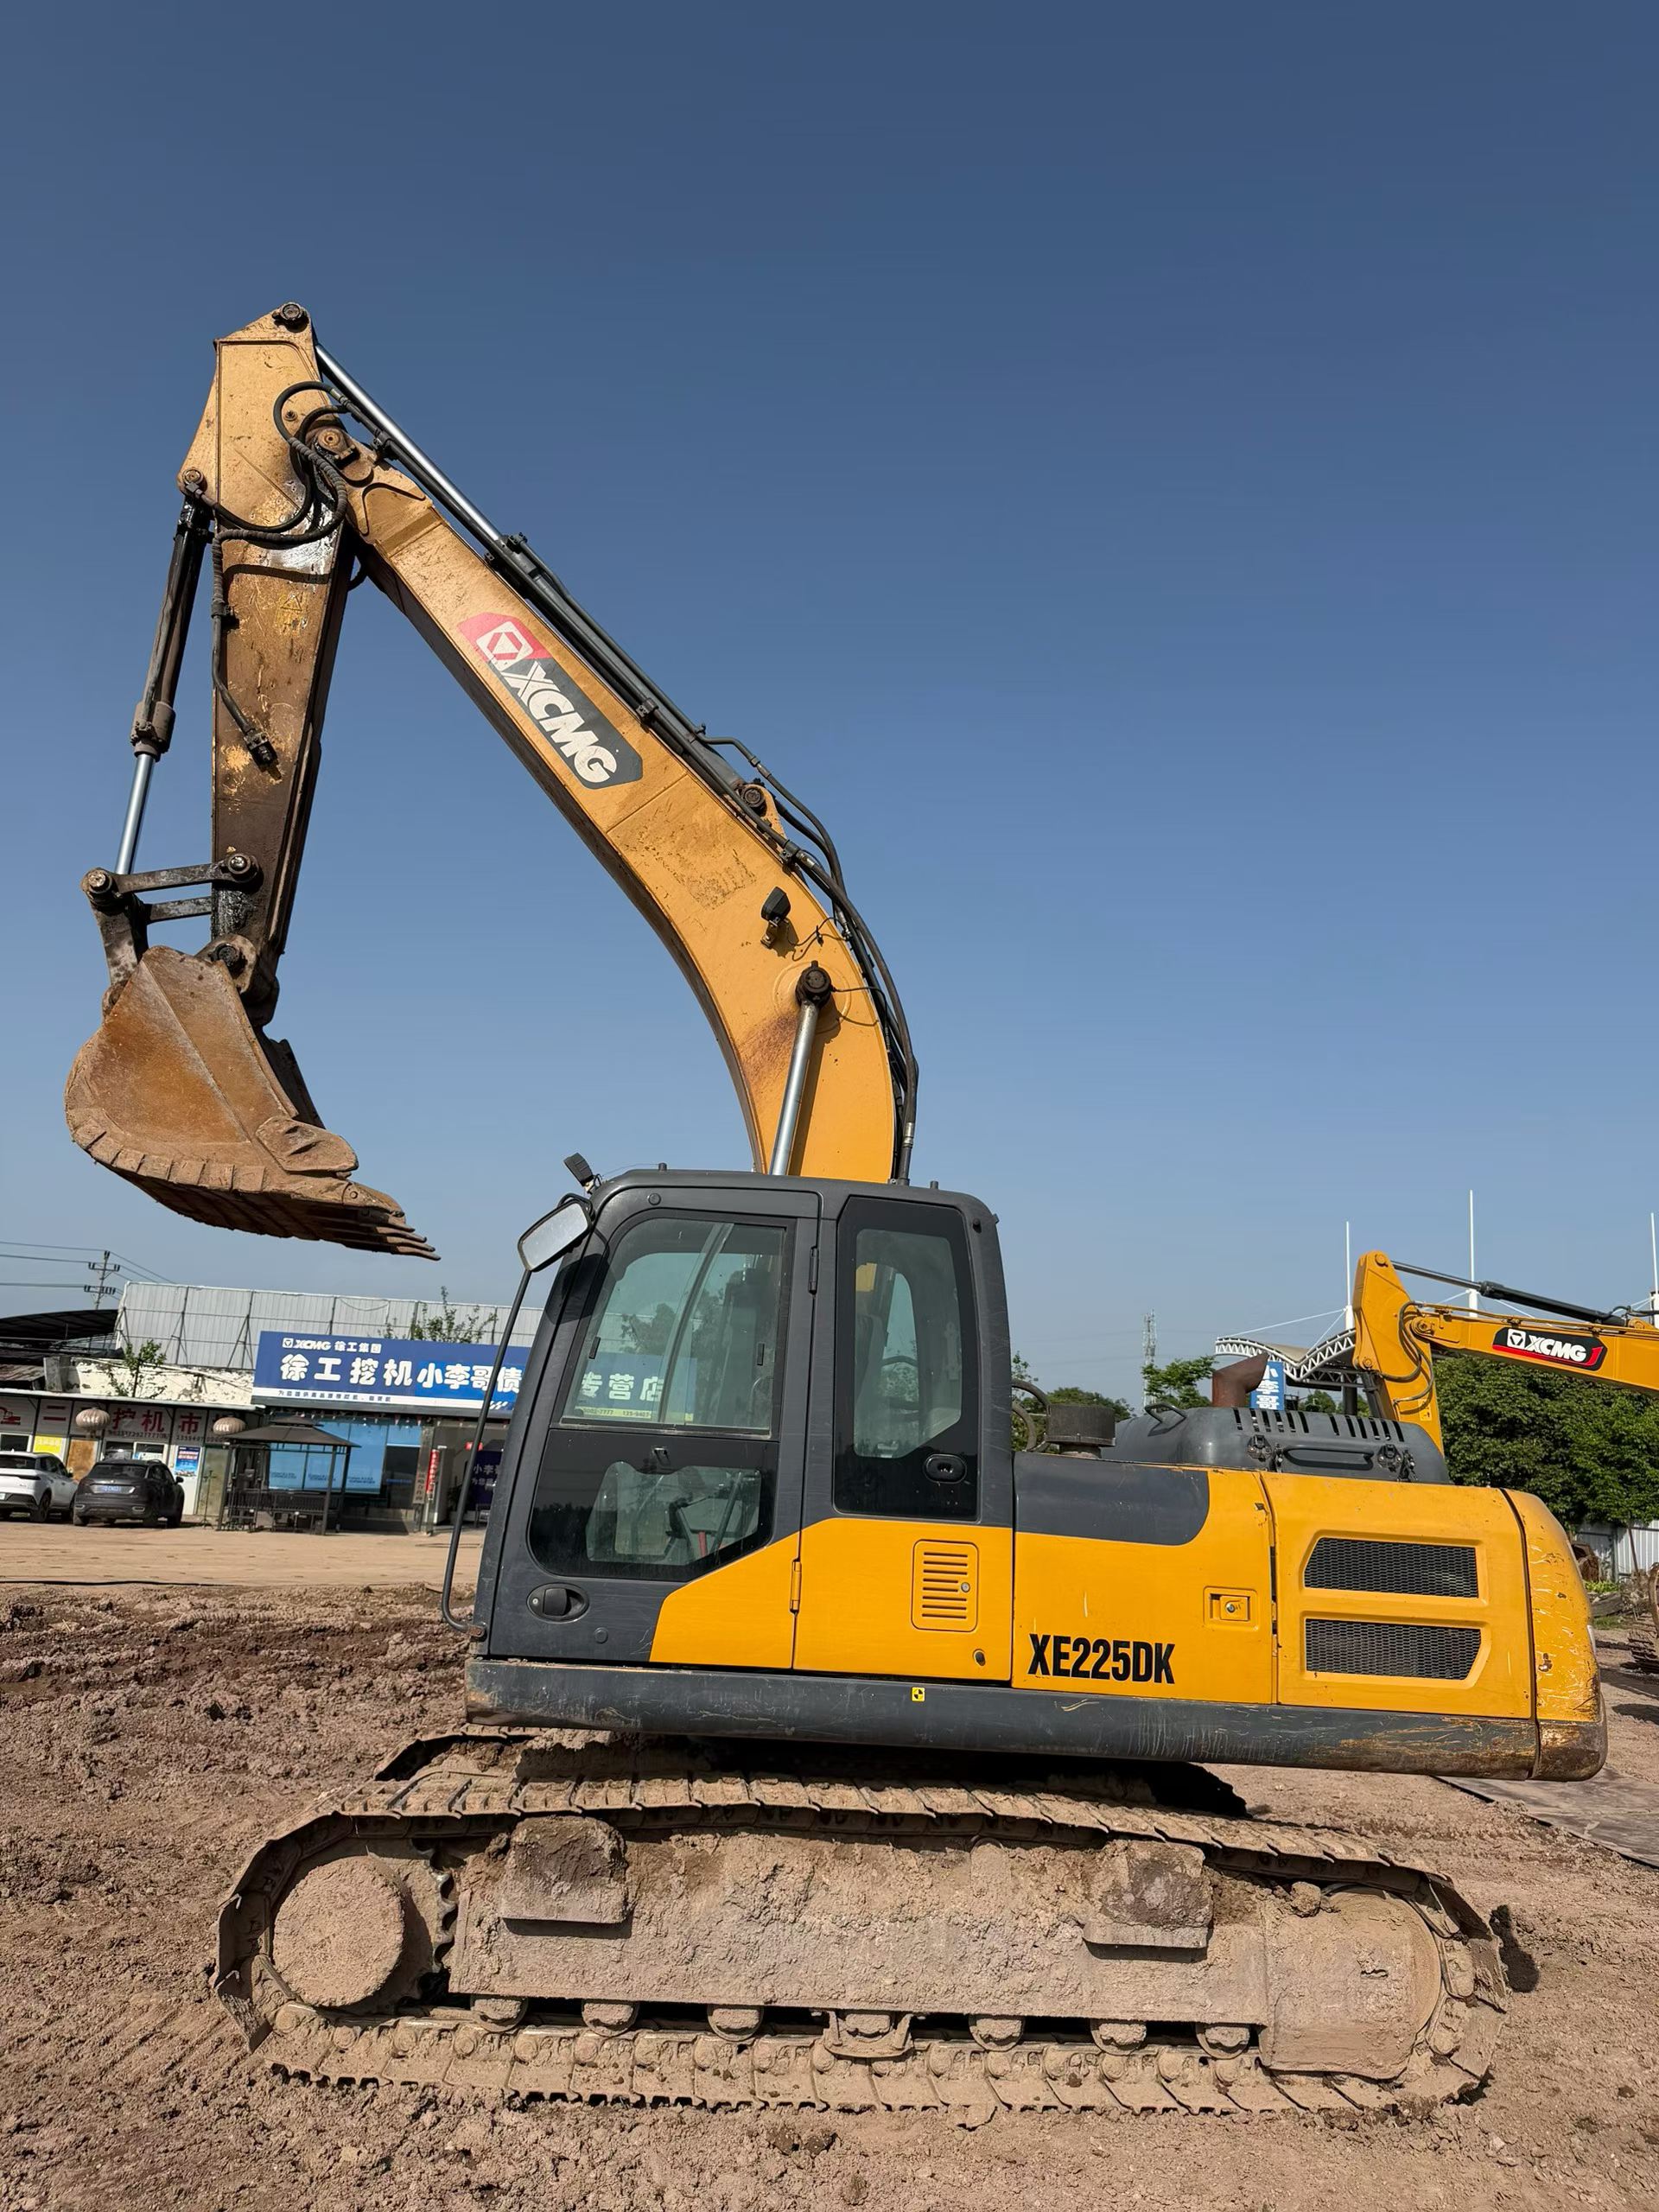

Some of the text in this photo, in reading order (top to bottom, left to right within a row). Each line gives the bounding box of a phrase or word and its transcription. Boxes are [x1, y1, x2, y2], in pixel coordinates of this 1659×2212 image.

[502, 661, 617, 783] XCMG
[1524, 1335, 1586, 1363] XCMG
[474, 1464, 498, 1475] 小李
[1027, 1633, 1175, 1684] XE225DK
